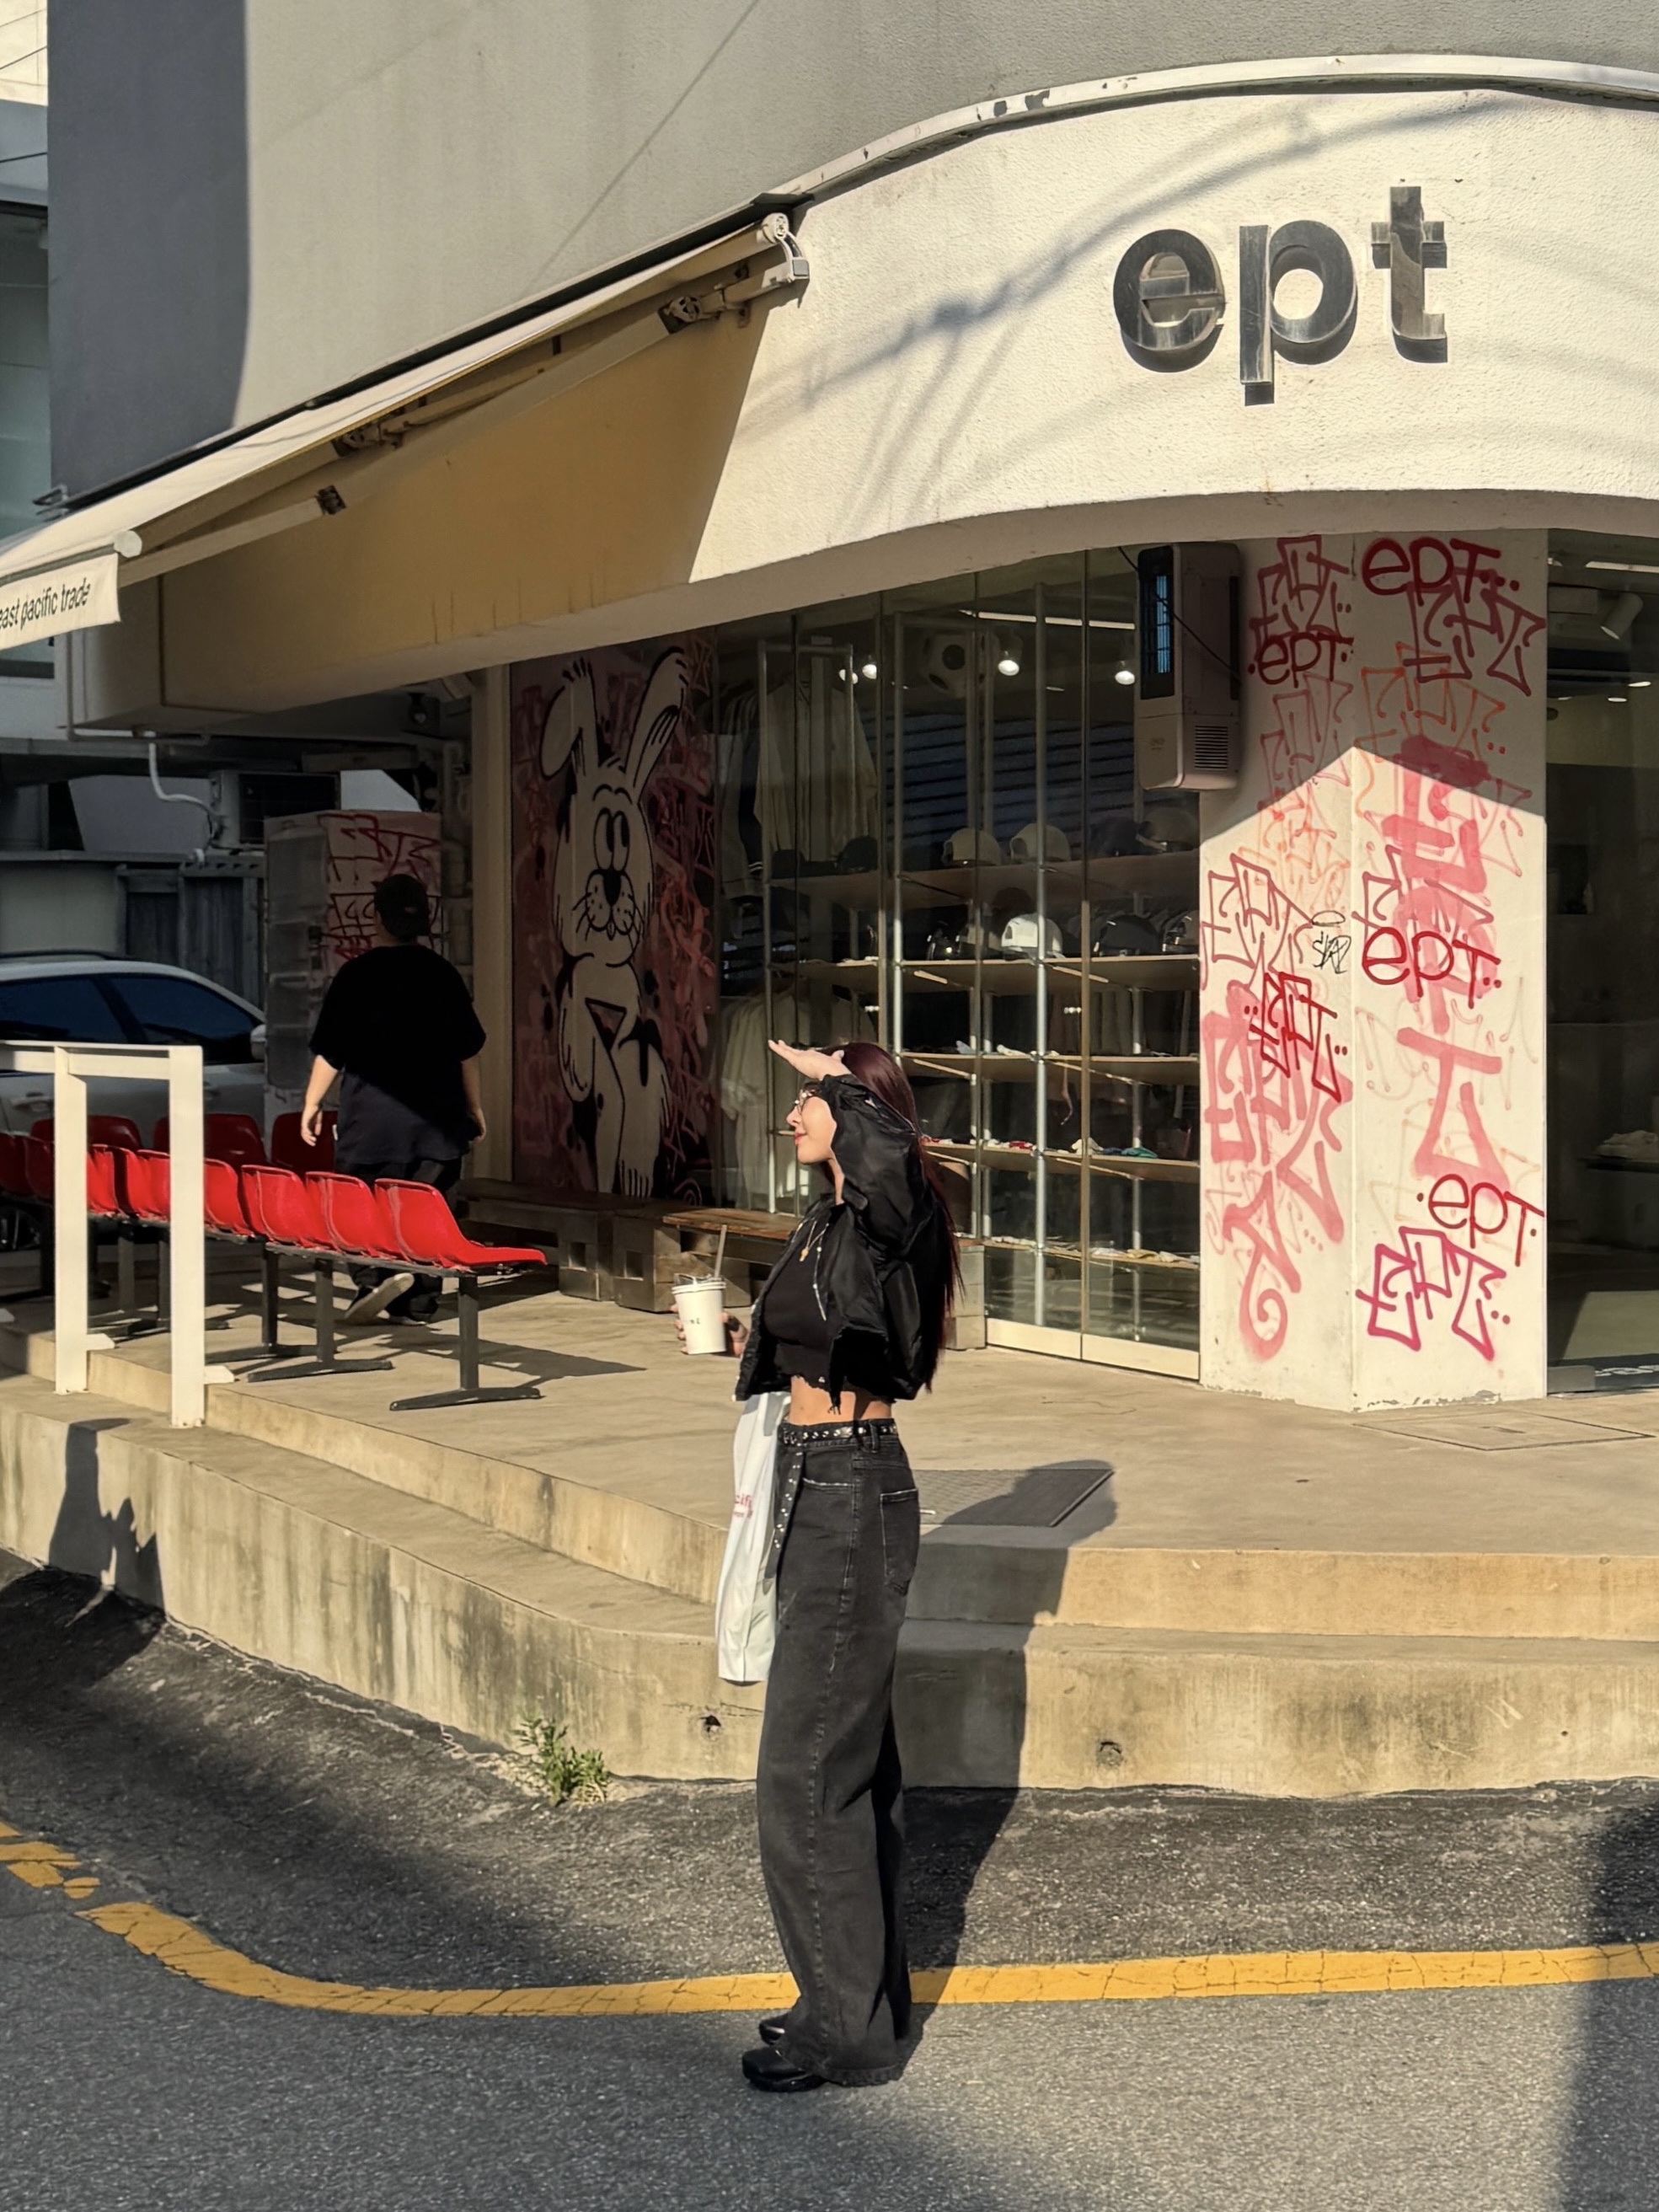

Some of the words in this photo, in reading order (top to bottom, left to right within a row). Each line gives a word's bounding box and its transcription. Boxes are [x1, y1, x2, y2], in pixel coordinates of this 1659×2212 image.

[1113, 186, 1448, 394] ept
[20, 586, 57, 630] pacific
[61, 577, 90, 613] trade
